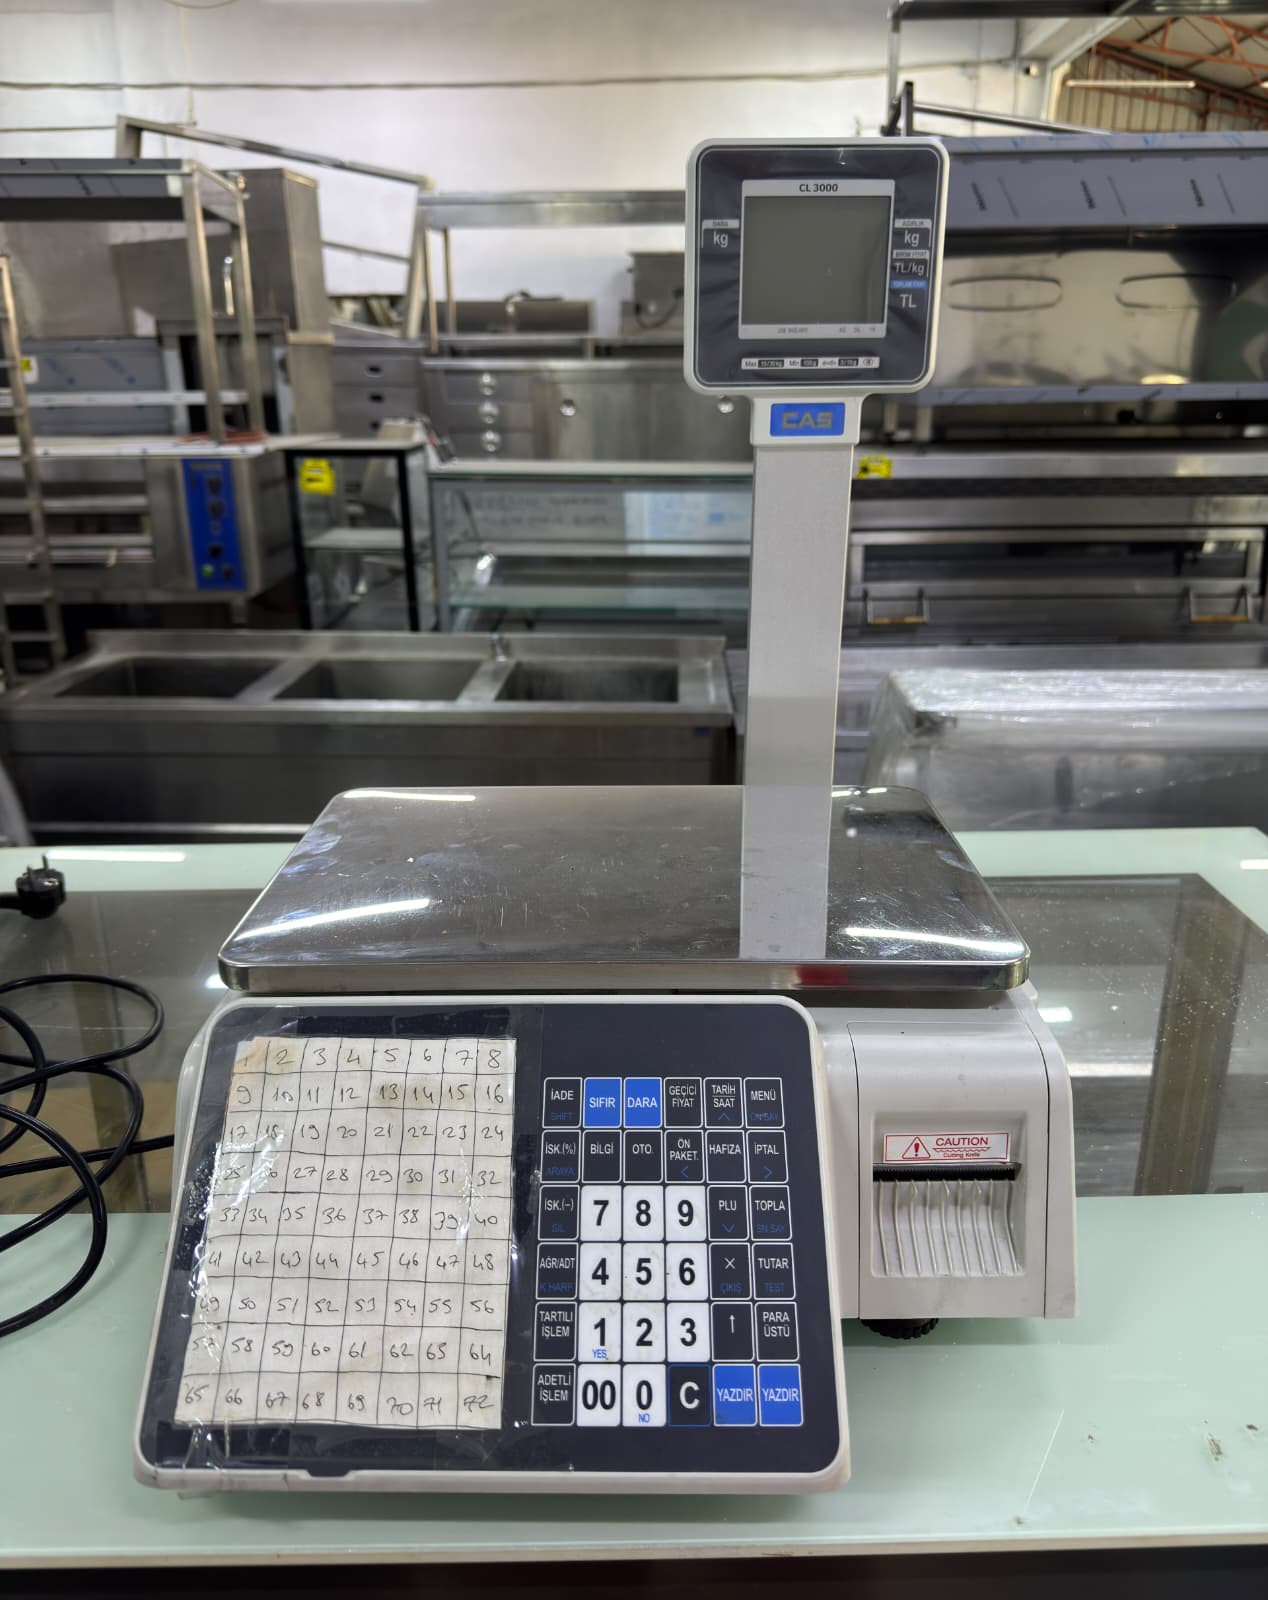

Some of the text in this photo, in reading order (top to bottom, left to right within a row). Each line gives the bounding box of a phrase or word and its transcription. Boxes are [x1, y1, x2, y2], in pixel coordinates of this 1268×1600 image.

[798, 183, 838, 193] CL 3000
[713, 231, 729, 248] kg
[904, 229, 920, 248] kg
[895, 262, 925, 276] TL/kg
[900, 294, 917, 309] TL
[781, 412, 832, 429] CAS
[276, 1048, 295, 1065] 2
[315, 1048, 328, 1066] 3
[347, 1053, 360, 1064] 4
[384, 1048, 399, 1063] 5
[424, 1050, 432, 1061] 6
[455, 1053, 474, 1065] 7
[488, 1050, 500, 1068] 8
[237, 1085, 504, 1104] 9 10 11 12 13 14 15 16
[551, 1089, 574, 1100] İADE
[669, 1085, 697, 1097] GEÇİCİ
[712, 1084, 735, 1094] TARİH
[751, 1090, 776, 1100] MENÜ
[589, 1097, 615, 1108] SIFIR
[628, 1097, 657, 1108] DARA
[672, 1098, 694, 1107] FİYAT
[713, 1098, 734, 1107] SAAT
[230, 1126, 248, 1140] 17
[301, 1124, 320, 1140] 19
[337, 1128, 358, 1138] 20
[375, 1125, 392, 1137] 21
[408, 1124, 434, 1137] 22
[443, 1124, 467, 1139] 23
[481, 1125, 503, 1141] 24
[590, 1143, 614, 1154] BİLGİ
[709, 1144, 741, 1154] HAFIZA
[754, 1142, 779, 1154] İPTAL
[935, 1137, 989, 1146] CAUTION
[294, 1166, 318, 1178] 27
[327, 1170, 348, 1181] 28
[366, 1170, 392, 1183] 29
[404, 1170, 423, 1183] 30
[439, 1170, 455, 1184] 31
[477, 1170, 502, 1185] 32
[719, 1200, 737, 1210] PLU
[755, 1200, 785, 1210] TOPLA
[248, 1208, 268, 1225] 34
[322, 1209, 346, 1223] 36
[362, 1210, 389, 1223] 37
[399, 1209, 418, 1224] 38
[434, 1211, 459, 1230] 39
[475, 1214, 498, 1226] 40
[593, 1200, 609, 1226] 7
[636, 1200, 651, 1226] 8
[678, 1200, 694, 1226] 9
[208, 1251, 494, 1271] 41 42 43 44 45 46 47 48
[540, 1256, 575, 1269] AĞR/ADT
[758, 1259, 788, 1269] TUTAR
[591, 1258, 609, 1285] 4
[636, 1258, 652, 1285] 5
[679, 1258, 695, 1285] 6
[238, 1298, 256, 1310] 50
[277, 1297, 298, 1313] 51
[315, 1300, 340, 1313] 52
[355, 1299, 376, 1311] 53
[394, 1300, 417, 1316] 54
[428, 1299, 453, 1313] 55
[470, 1300, 495, 1314] 56
[540, 1312, 573, 1322] TARTILI
[763, 1312, 789, 1322] PARA
[542, 1324, 570, 1339] İŞLEM
[594, 1318, 606, 1346] 1
[636, 1319, 653, 1346] 2
[680, 1318, 696, 1346] 3
[764, 1325, 790, 1337] ÜSTÜ
[231, 1339, 253, 1353] 58
[272, 1343, 294, 1357] 59
[311, 1344, 330, 1356] 60
[348, 1343, 366, 1358] 61
[390, 1343, 414, 1358] 62
[469, 1343, 491, 1366] 64
[592, 1349, 607, 1358] YES
[538, 1373, 571, 1385] ADETLİ
[184, 1383, 496, 1417] 65 66 67 68 69 70 71 72
[540, 1388, 568, 1403] İŞLEM
[582, 1380, 616, 1410] 00
[636, 1380, 653, 1410] 0
[679, 1382, 700, 1408] C
[717, 1389, 753, 1400] YAZDIR
[762, 1389, 798, 1400] YAZDIR
[639, 1413, 649, 1423] NO
